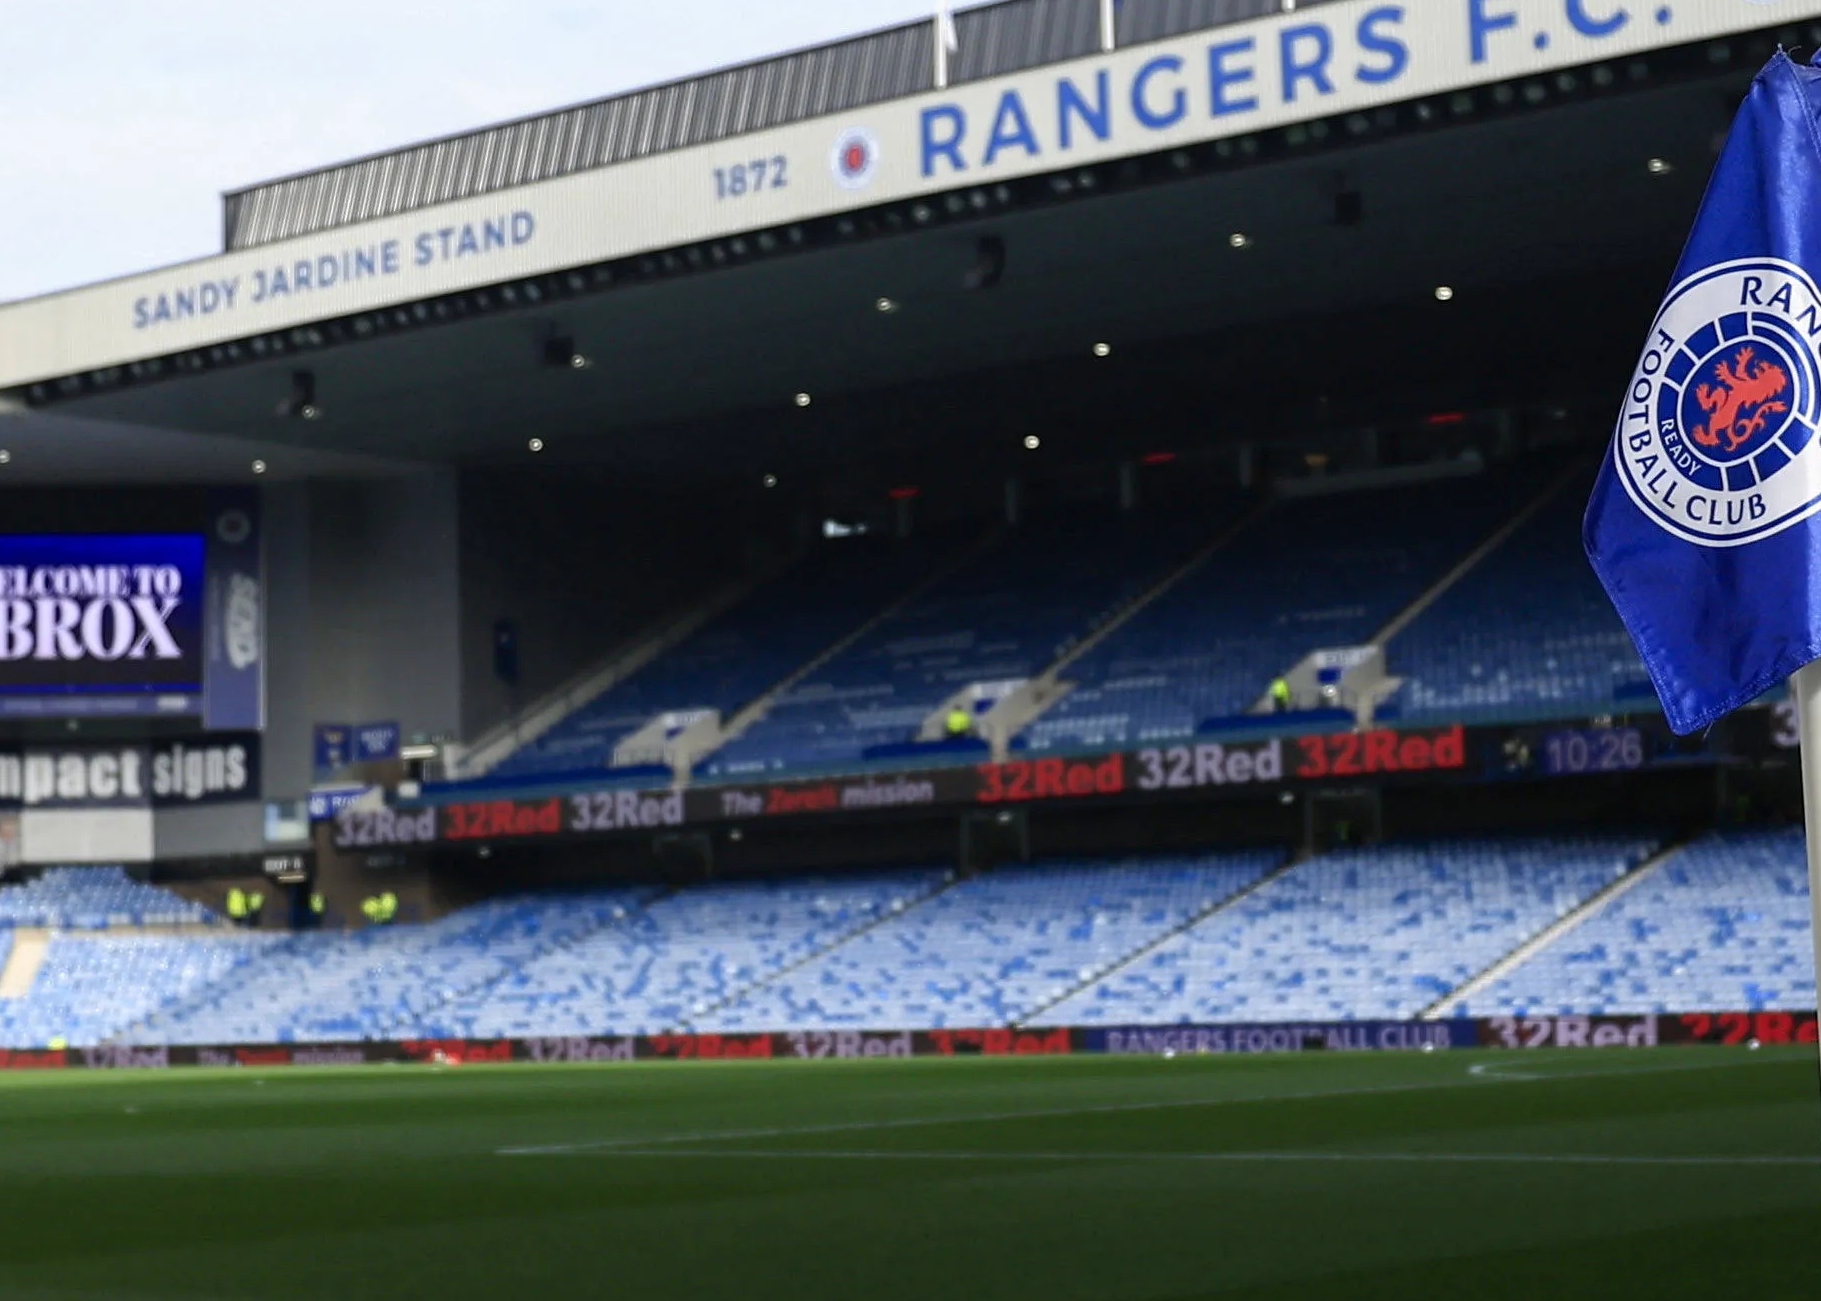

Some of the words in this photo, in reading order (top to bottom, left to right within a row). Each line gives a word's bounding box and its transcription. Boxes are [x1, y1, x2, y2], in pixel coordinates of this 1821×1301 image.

[917, 3, 1411, 178] RANGERS
[713, 155, 789, 200] 1872
[132, 275, 241, 329] SANDY
[250, 240, 400, 304] JARDINE
[415, 210, 535, 266] STAND
[1625, 325, 1677, 510] FOOTBALL
[1686, 492, 1767, 525] CLUB
[1661, 417, 1702, 476] READY
[133, 565, 182, 597] TO
[153, 744, 247, 799] signs
[1138, 740, 1282, 789] 32Red
[1298, 725, 1464, 777] 32Red
[1547, 731, 1642, 771] 10:26
[976, 754, 1124, 803] 32Red
[445, 799, 560, 839] 32Red
[571, 788, 684, 831] 32Red
[1380, 1020, 1451, 1049] CLUB
